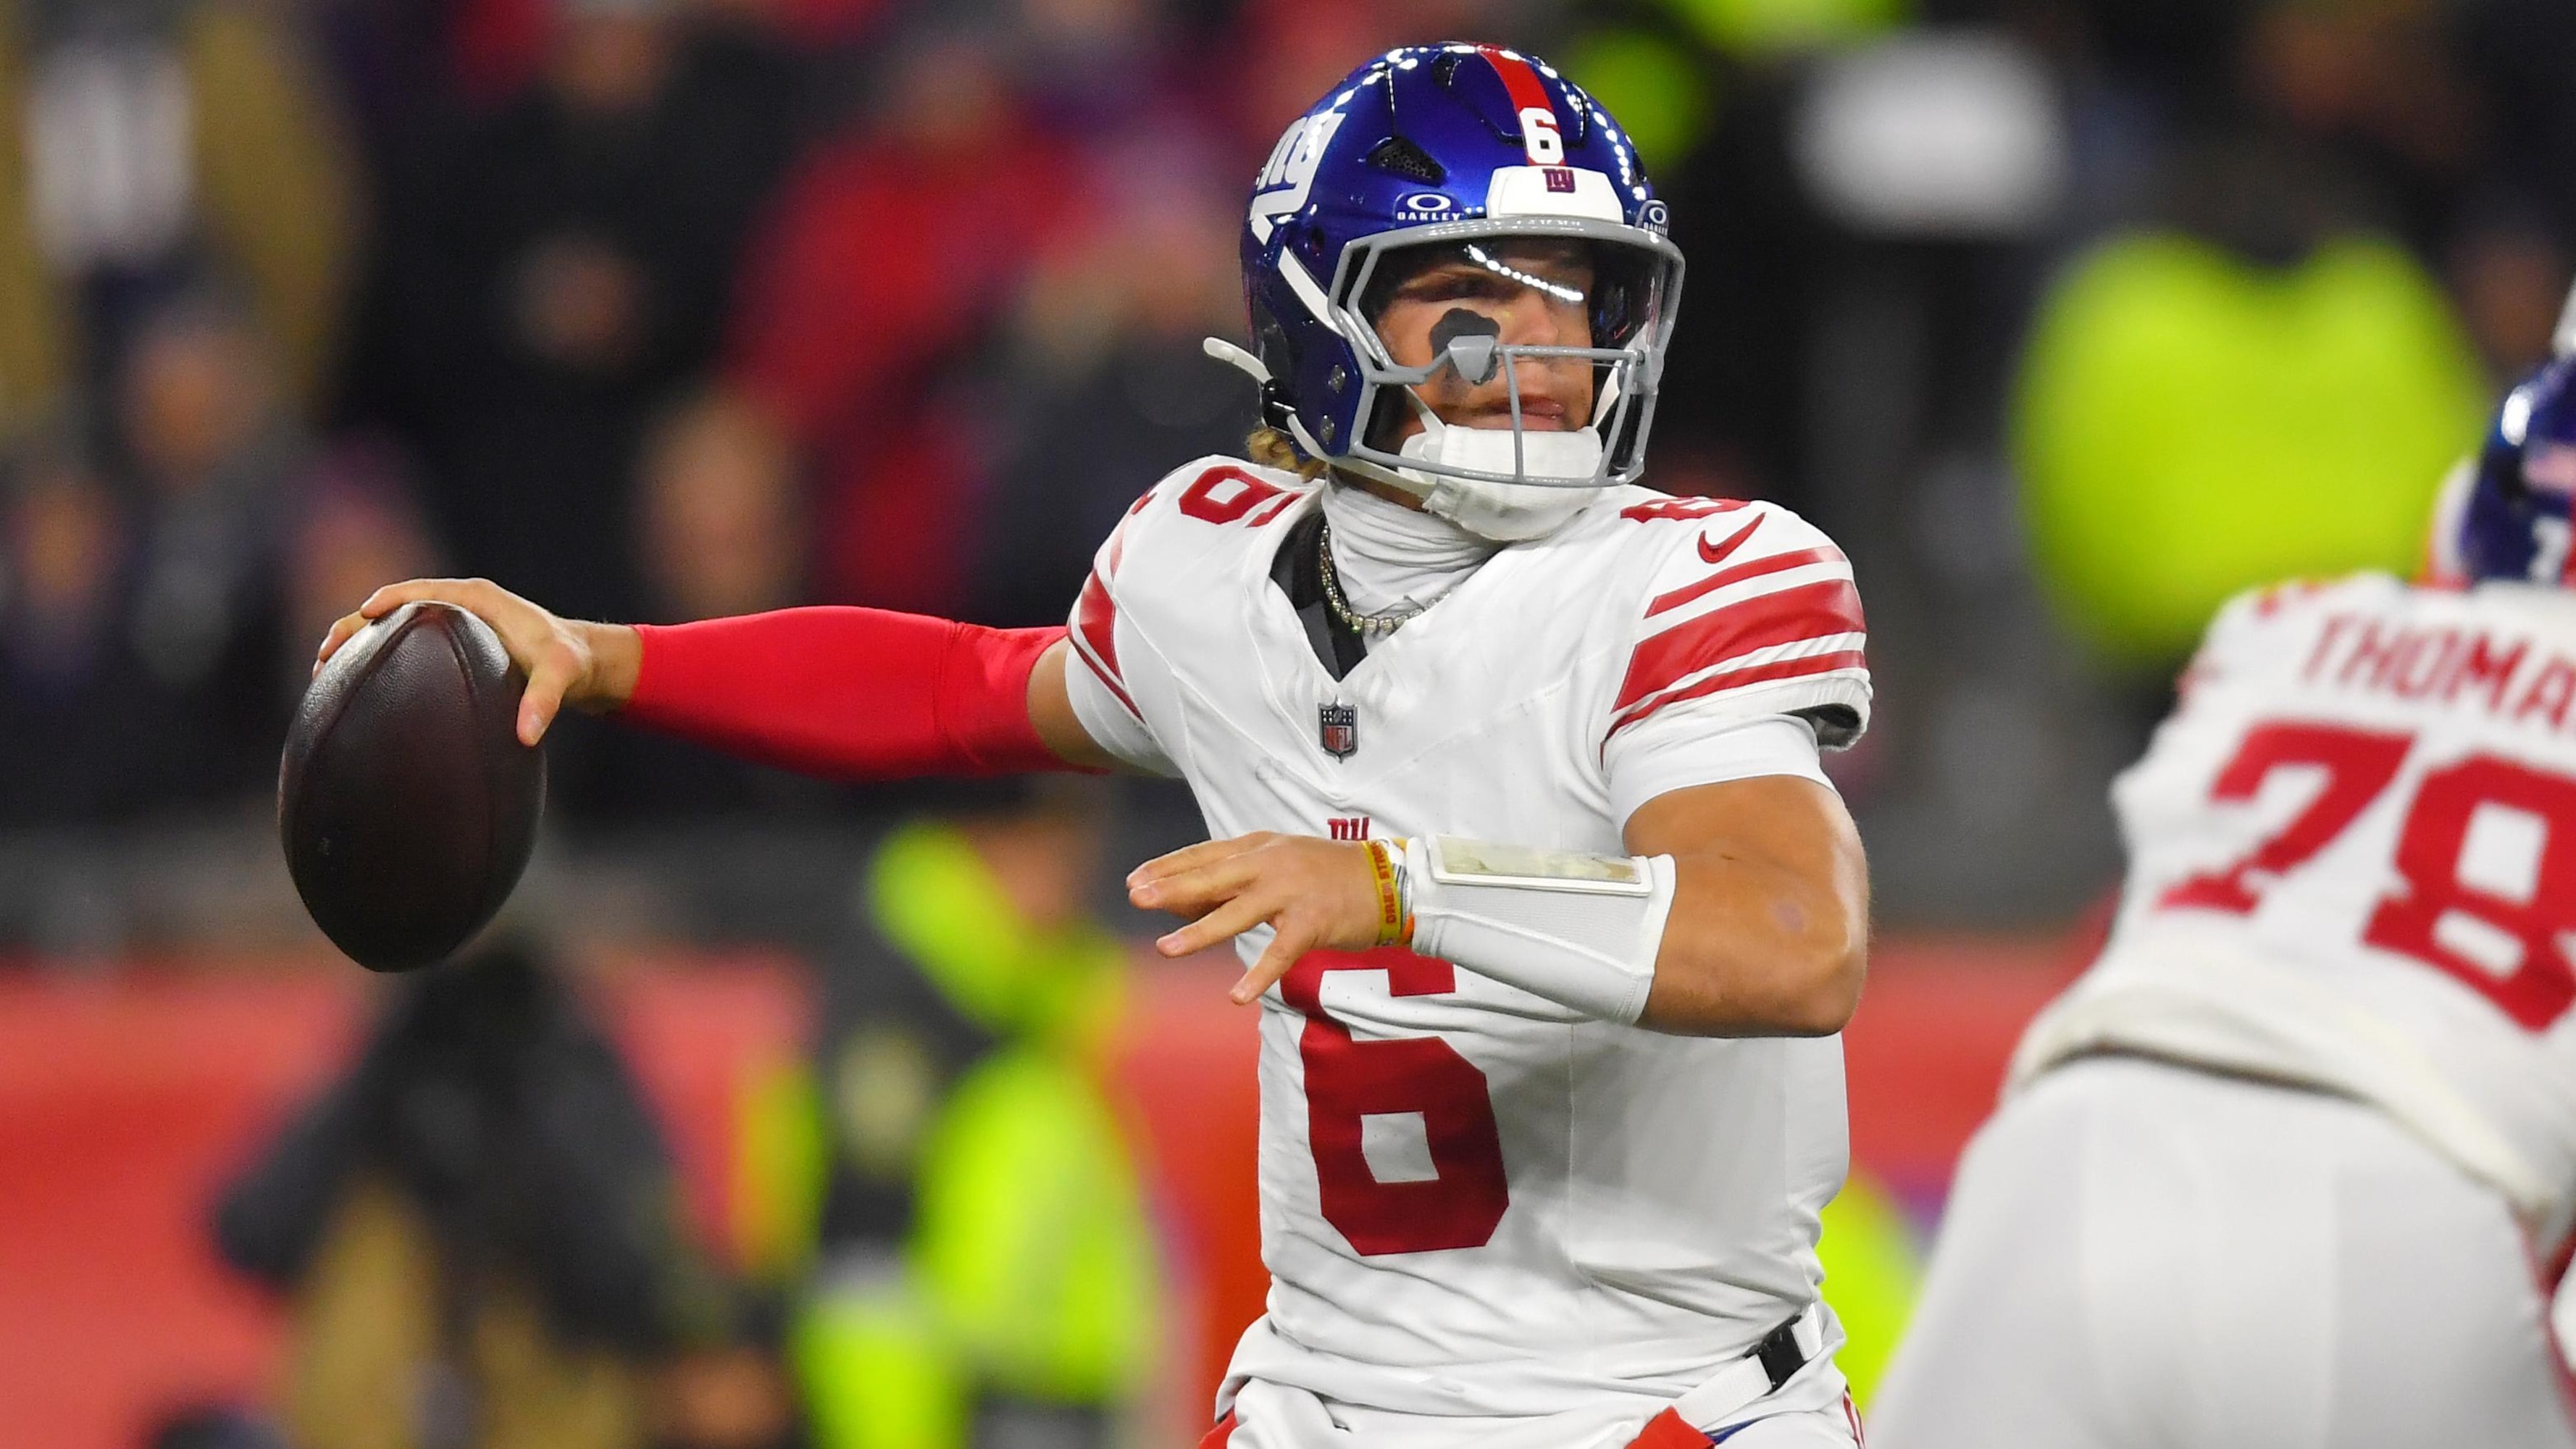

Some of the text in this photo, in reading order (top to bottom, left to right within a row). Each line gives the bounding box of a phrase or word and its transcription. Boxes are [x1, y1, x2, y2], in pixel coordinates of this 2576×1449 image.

[1519, 107, 1564, 165] 6
[1397, 211, 1462, 221] OAKLEY
[2300, 612, 2576, 734] THOMA
[2153, 714, 2576, 1036] 78
[1280, 946, 1510, 1257] 6
